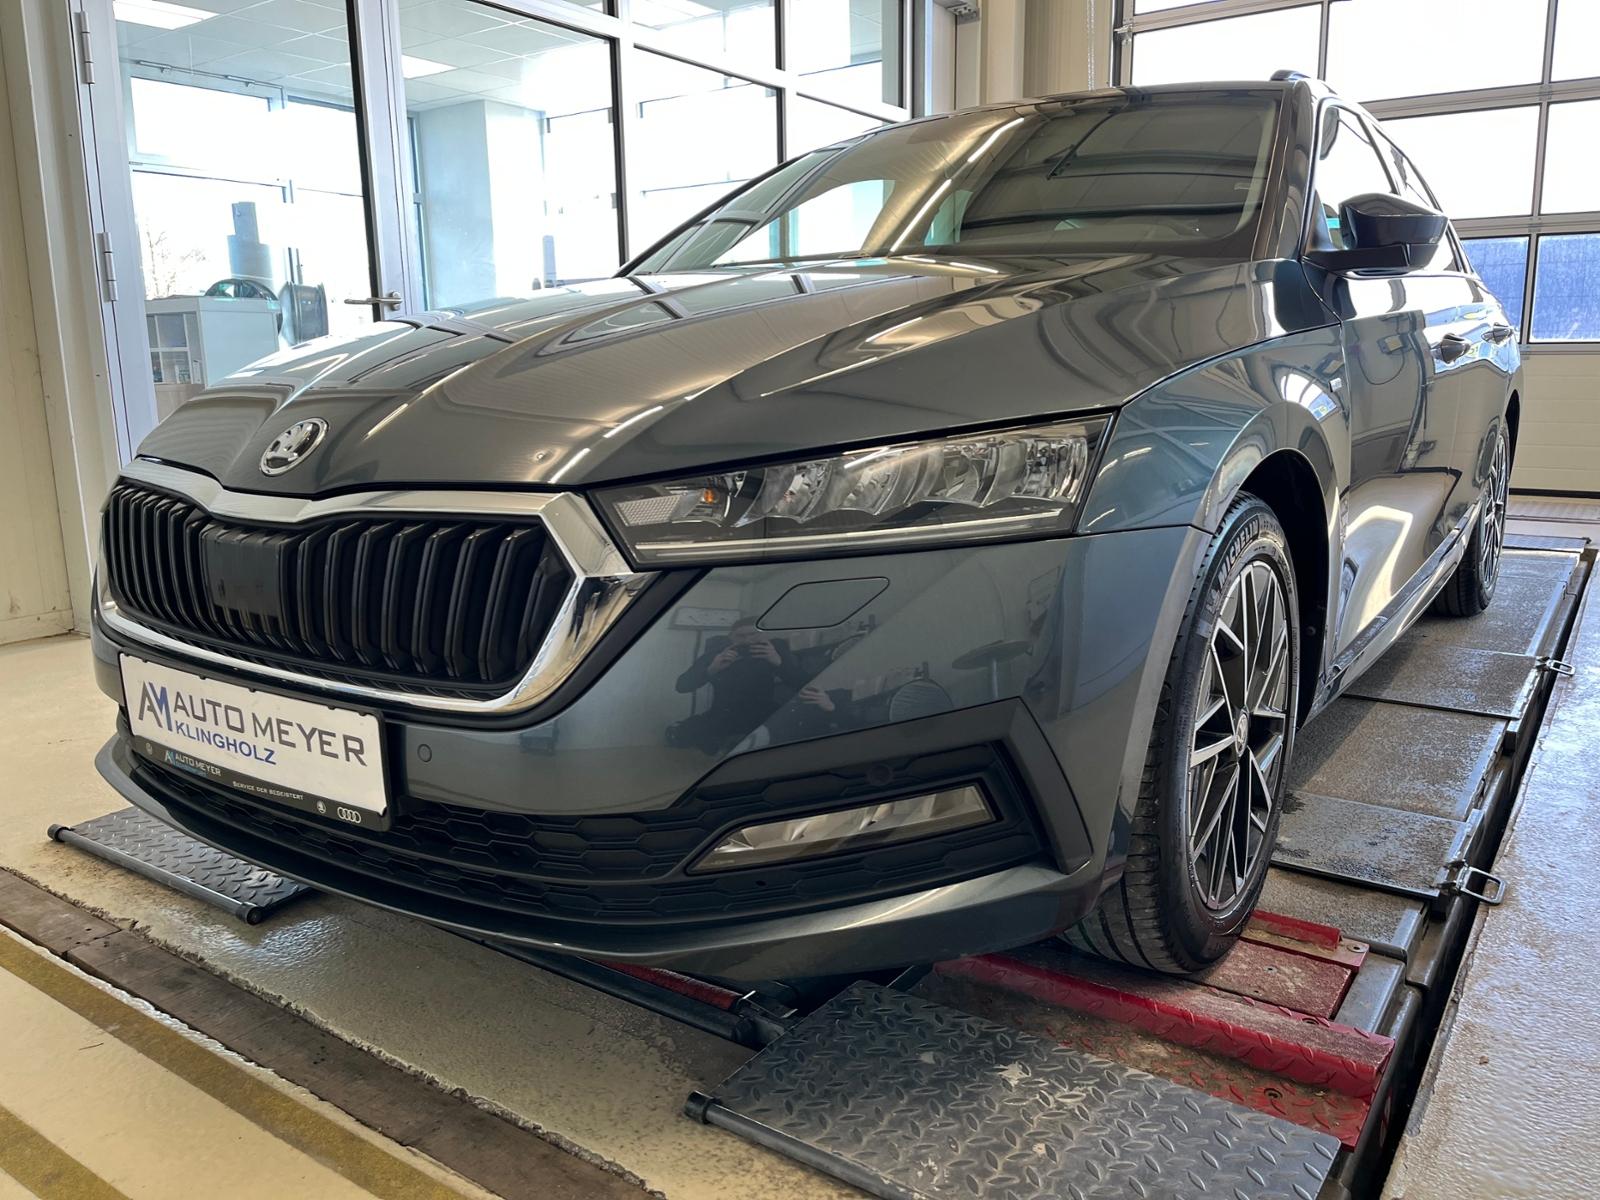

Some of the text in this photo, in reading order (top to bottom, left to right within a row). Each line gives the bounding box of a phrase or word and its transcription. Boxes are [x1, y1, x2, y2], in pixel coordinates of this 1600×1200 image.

[1217, 519, 1259, 588] MICHELIN
[173, 691, 245, 733] AUTO
[251, 712, 367, 766] MEYER
[175, 720, 277, 765] KLINGHOLZ
[175, 753, 195, 766] AUTO
[195, 758, 222, 777] MEYER
[232, 780, 255, 791] SERVICE
